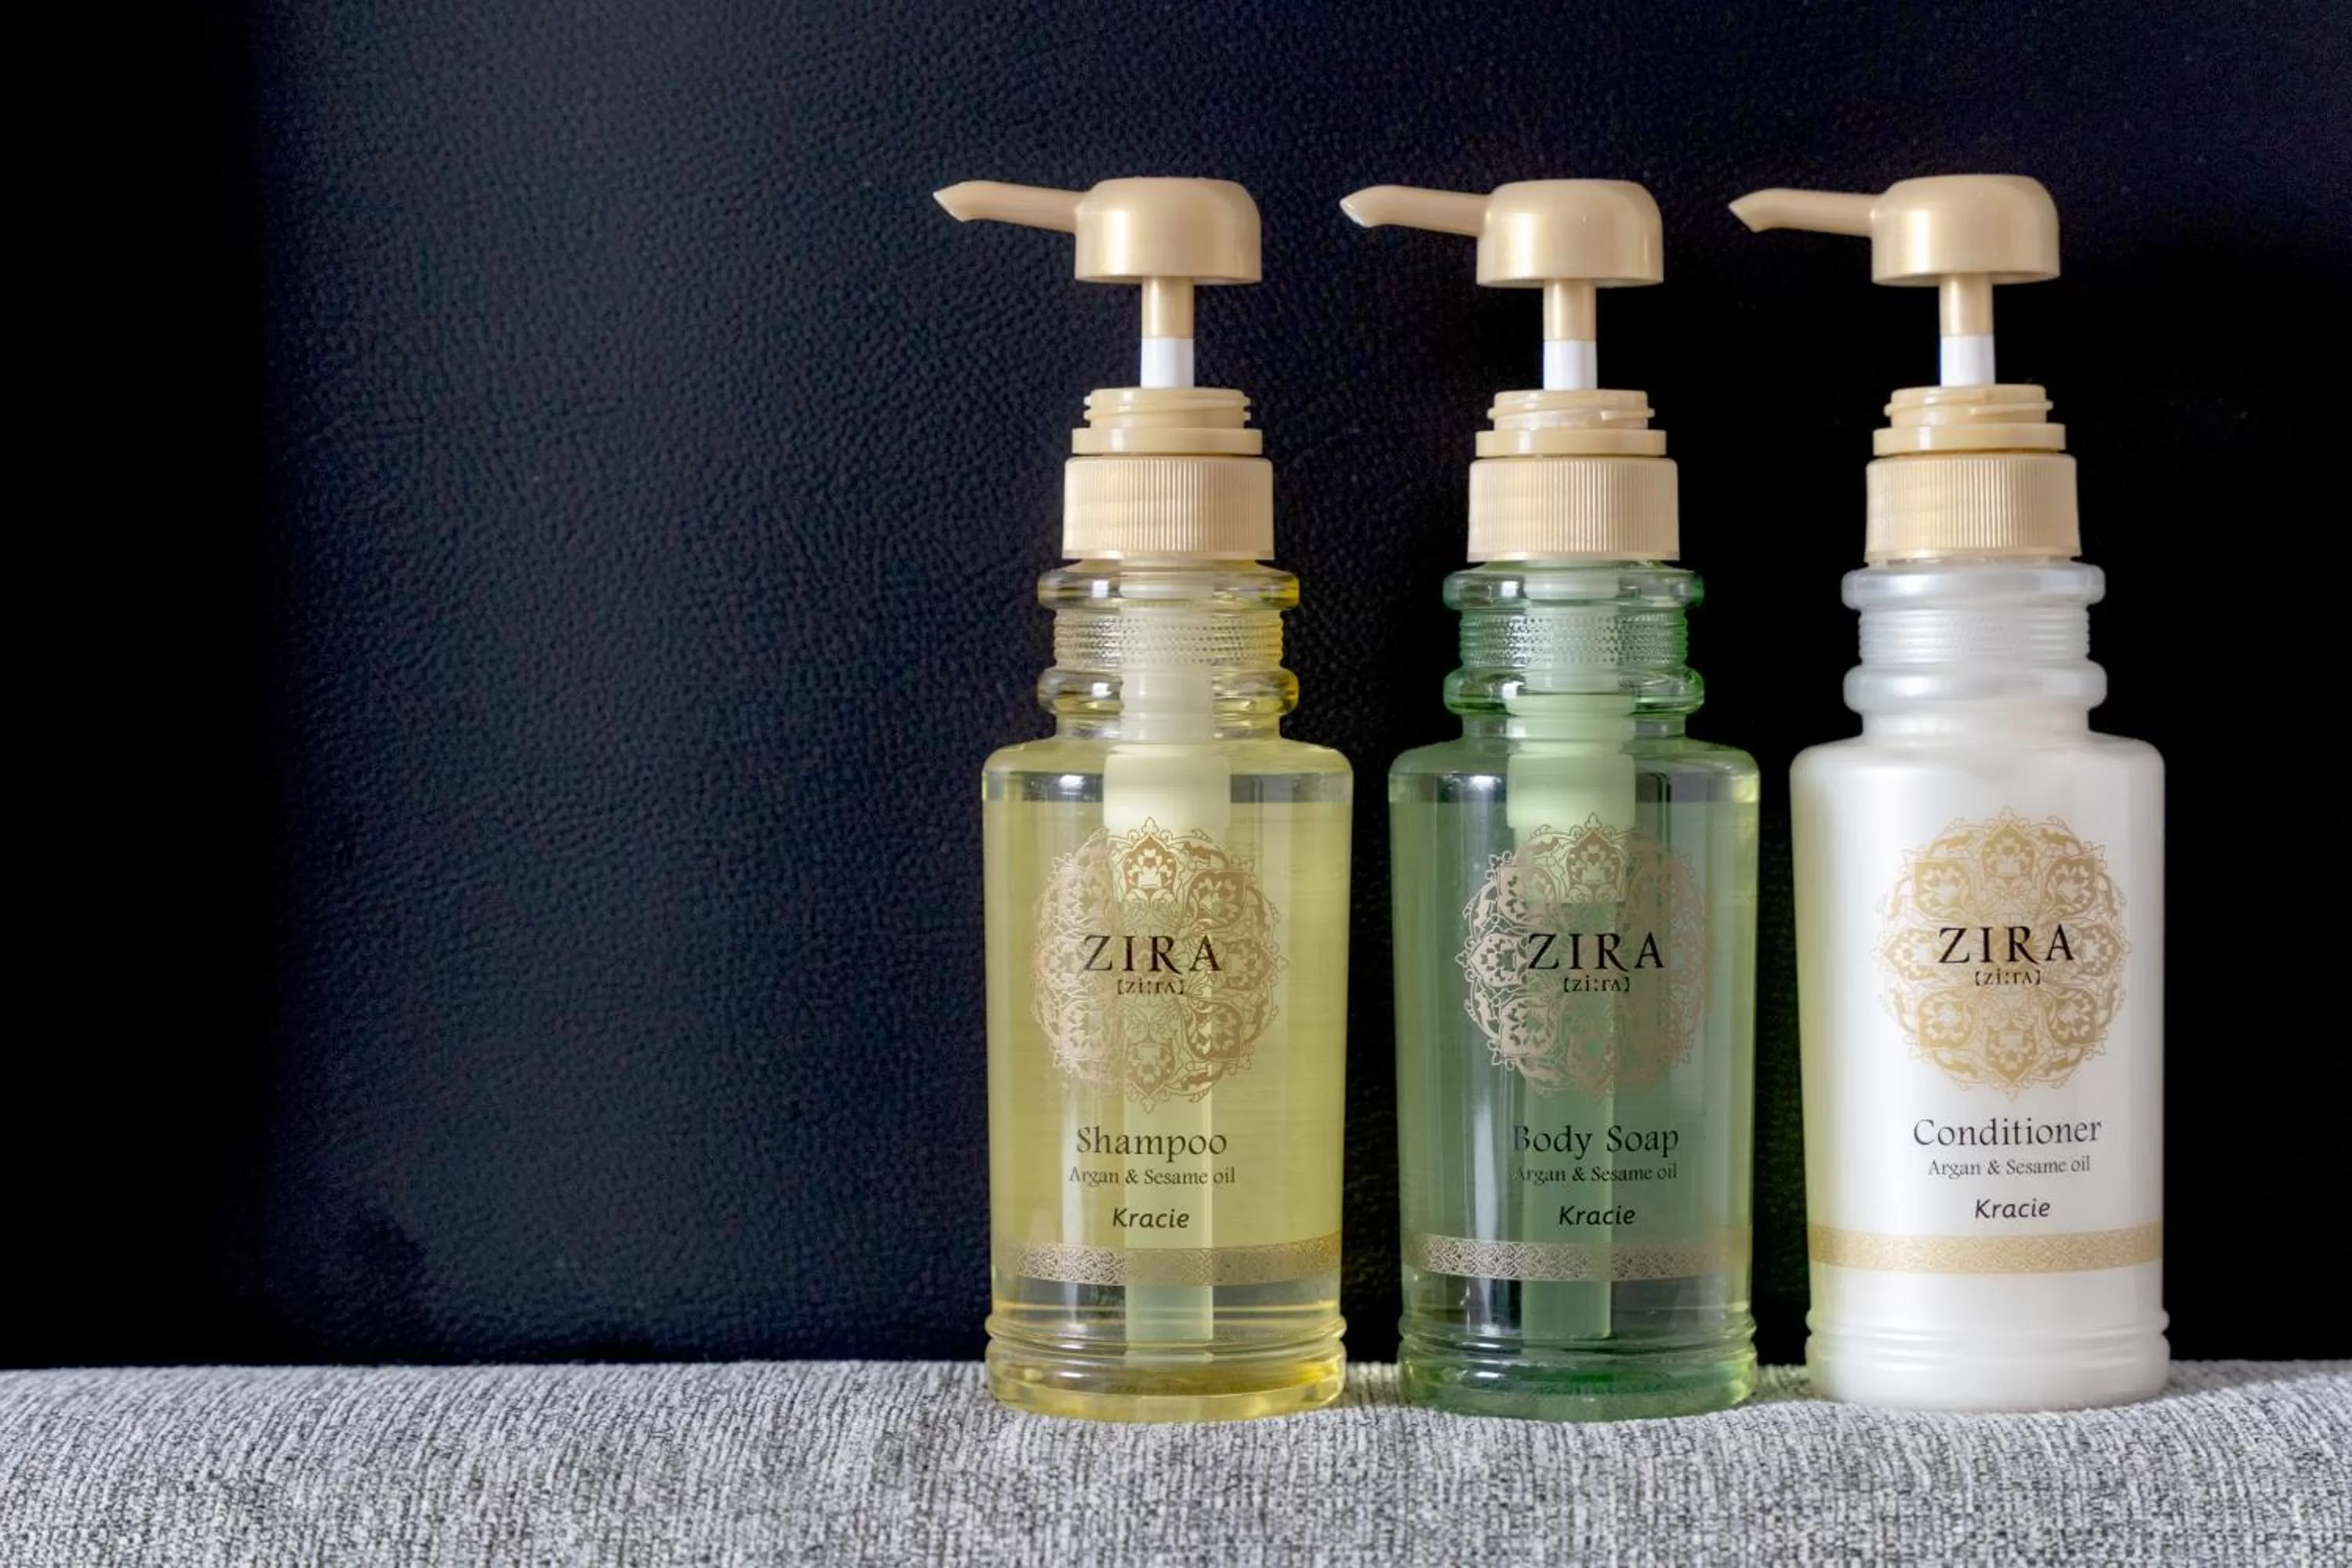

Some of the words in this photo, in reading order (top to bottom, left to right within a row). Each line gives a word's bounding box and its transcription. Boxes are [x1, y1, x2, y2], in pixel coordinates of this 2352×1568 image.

[1083, 934, 1224, 975] ZIRA
[1527, 932, 1665, 972] ZIRA
[1938, 924, 2074, 965] ZIRA
[1076, 1126, 1227, 1163] Shampoo
[1513, 1125, 1592, 1160] Body
[1606, 1125, 1679, 1159] Soap
[1913, 1117, 2103, 1146] Conditioner
[1069, 1167, 1120, 1187] Argan
[1125, 1170, 1138, 1185] &
[1144, 1168, 1209, 1185] Sesame
[1213, 1167, 1236, 1183] oil
[1514, 1166, 1566, 1185] Argan
[1572, 1168, 1586, 1181] &
[1592, 1166, 1653, 1181] Sesame
[1657, 1163, 1677, 1180] oil
[1928, 1159, 1981, 1179] Argan
[1987, 1161, 2000, 1176] &
[2006, 1159, 2067, 1174] Sesame
[2071, 1155, 2090, 1172] oil
[1112, 1207, 1189, 1229] Kracie
[1559, 1205, 1635, 1226] Kracie
[1975, 1198, 2050, 1219] Kracie
